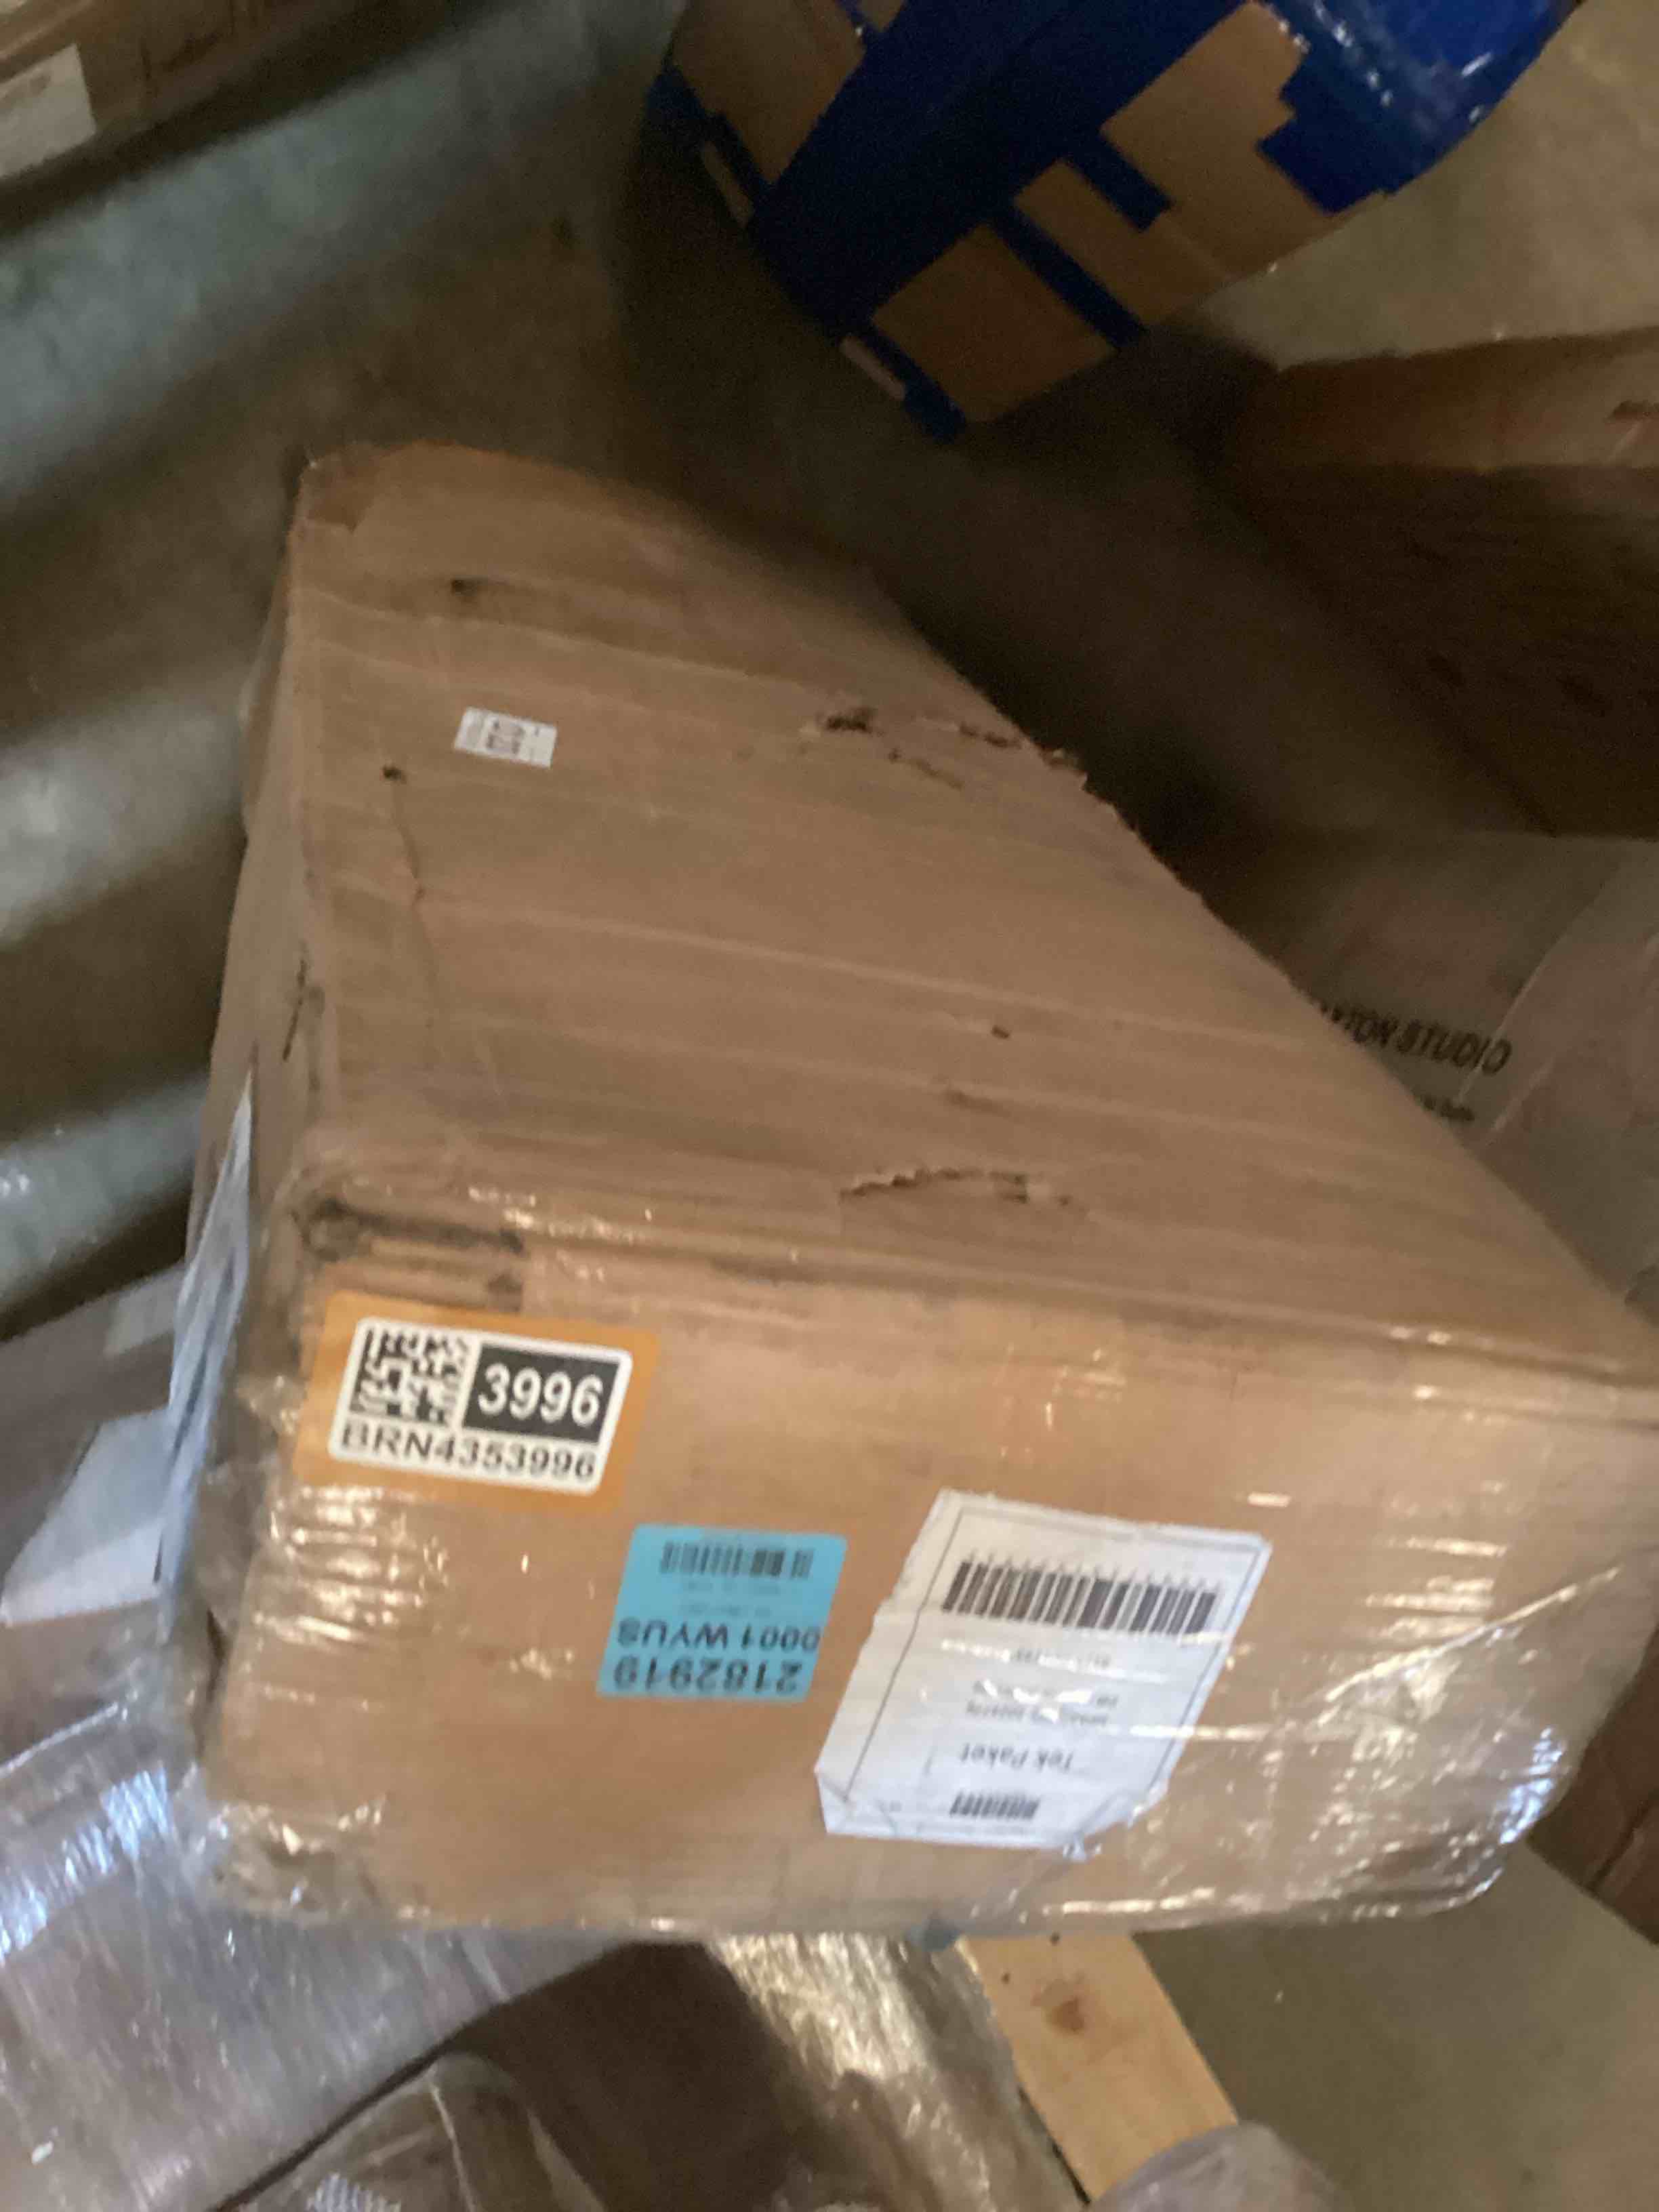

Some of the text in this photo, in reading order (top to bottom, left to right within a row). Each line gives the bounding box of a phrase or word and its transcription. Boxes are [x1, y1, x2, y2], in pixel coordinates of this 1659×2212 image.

[1397, 1019, 1513, 1076] STUDIO
[477, 1362, 605, 1428] 3996
[341, 1422, 595, 1480] BRN4353996
[741, 1624, 821, 1653] 0001
[959, 1742, 1073, 1773] Tek Paket
